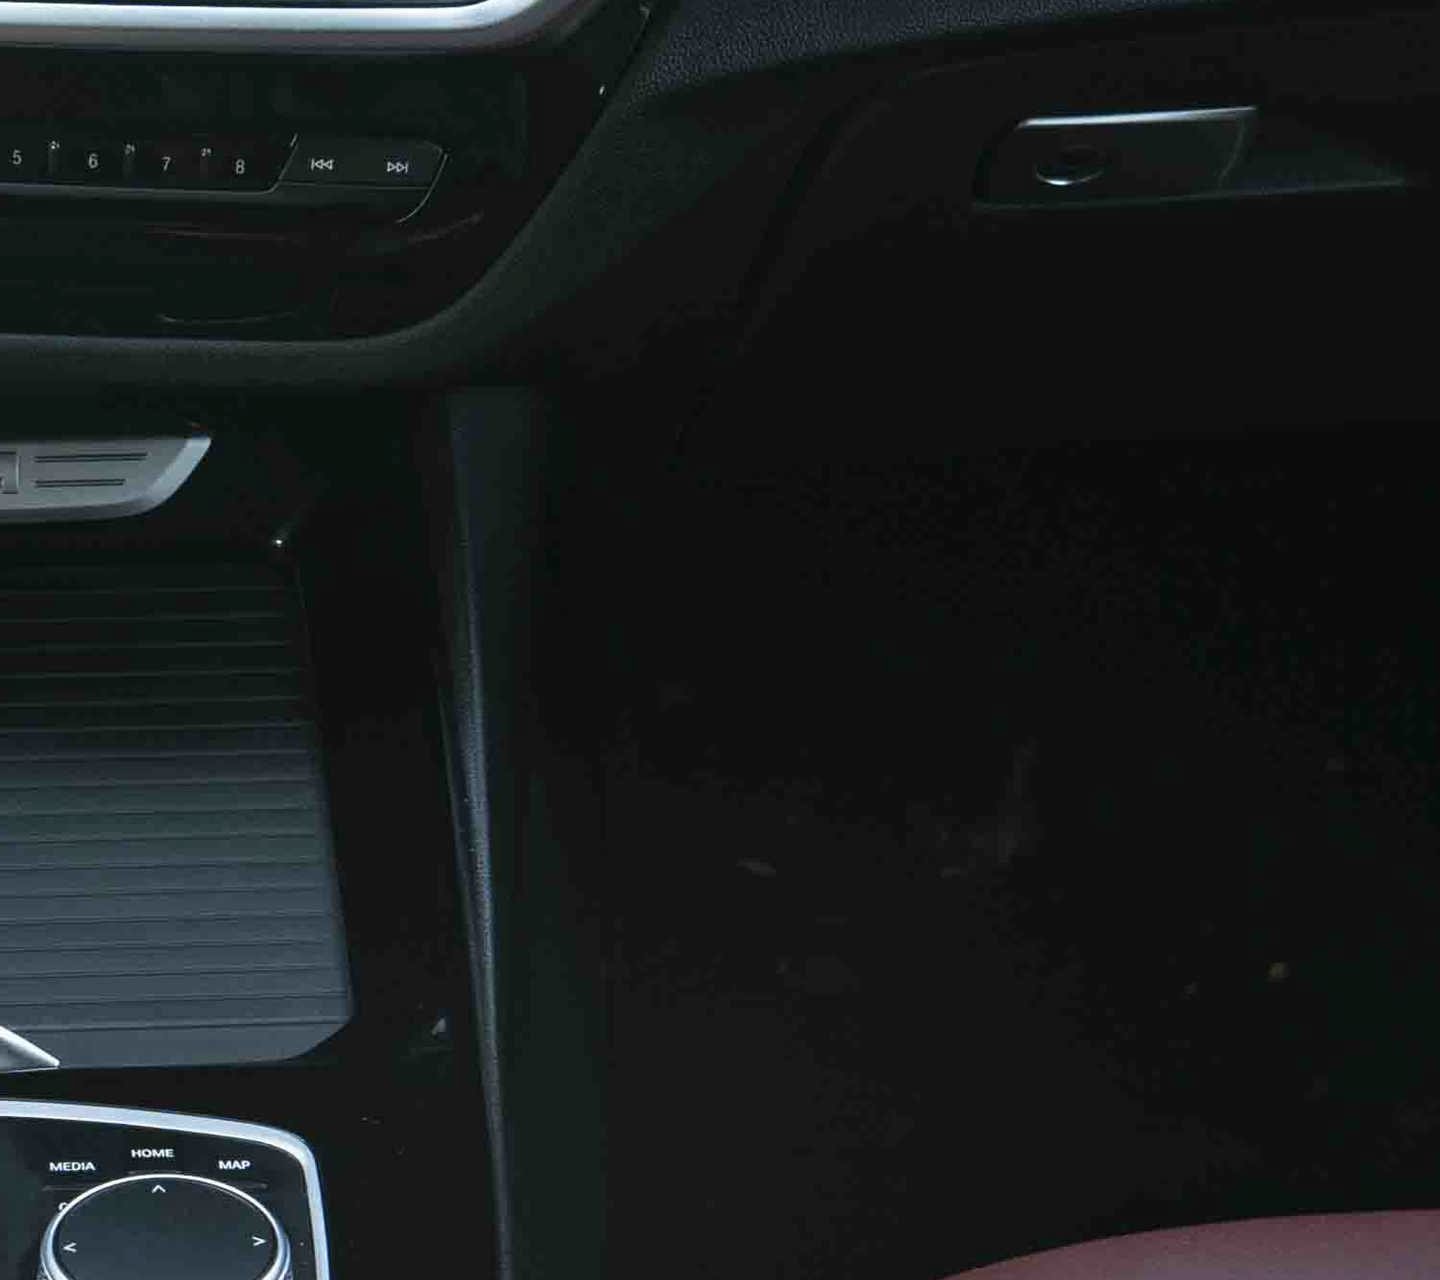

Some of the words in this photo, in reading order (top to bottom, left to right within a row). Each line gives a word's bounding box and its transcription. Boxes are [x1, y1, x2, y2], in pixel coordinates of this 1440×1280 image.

[12, 150, 22, 165] 5
[88, 153, 98, 168] 6
[161, 156, 171, 171] 7
[235, 159, 245, 174] 8
[131, 1148, 175, 1158] HOME
[49, 1161, 96, 1171] MEDIA
[218, 1160, 251, 1170] MAP
